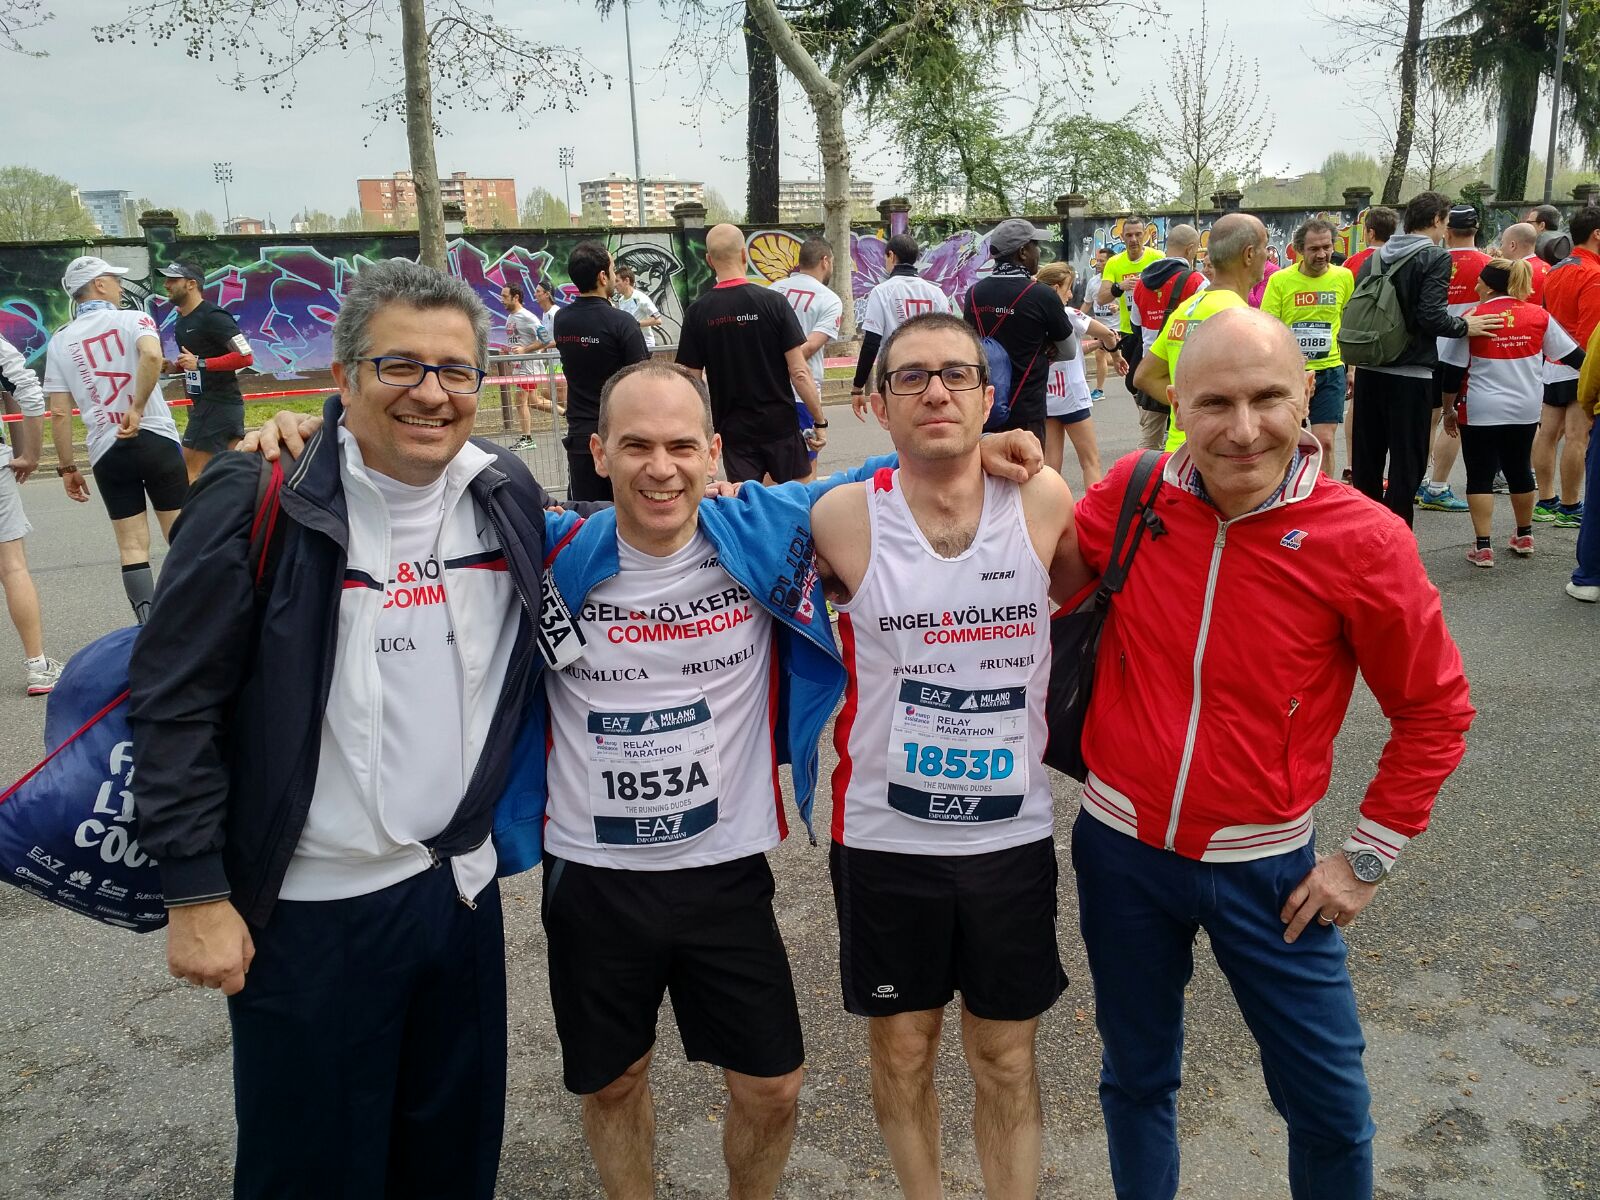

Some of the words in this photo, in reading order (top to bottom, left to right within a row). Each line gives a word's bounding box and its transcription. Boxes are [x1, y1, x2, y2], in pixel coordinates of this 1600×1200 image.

[383, 584, 446, 608] COMM
[607, 605, 753, 643] COMMERCIAL
[879, 603, 1037, 632] ENGEL&VÖLKERS
[924, 622, 1036, 645] COMMERCIAL
[681, 644, 755, 675] #RUN4ELI
[920, 687, 953, 704] EA7
[980, 691, 1011, 703] MILANO
[980, 700, 1011, 708] MARATHON
[602, 717, 631, 729] EA7
[660, 708, 695, 722] MILANO
[661, 714, 696, 727] MARATHON
[937, 715, 971, 727] RELAY
[936, 725, 994, 736] MARATHON
[623, 739, 655, 749] RELAY
[624, 744, 682, 758] MARATHON
[903, 742, 1014, 781] 1853D
[602, 760, 709, 801] 1853A
[924, 781, 940, 789] THE
[940, 782, 969, 792] RUNNING
[969, 784, 993, 792] DUDES
[625, 805, 638, 814] THE
[638, 803, 669, 813] RUNNING
[670, 798, 692, 809] DUDES
[929, 794, 982, 815] EA7
[635, 813, 684, 837] EA7
[30, 845, 66, 870] EA7
